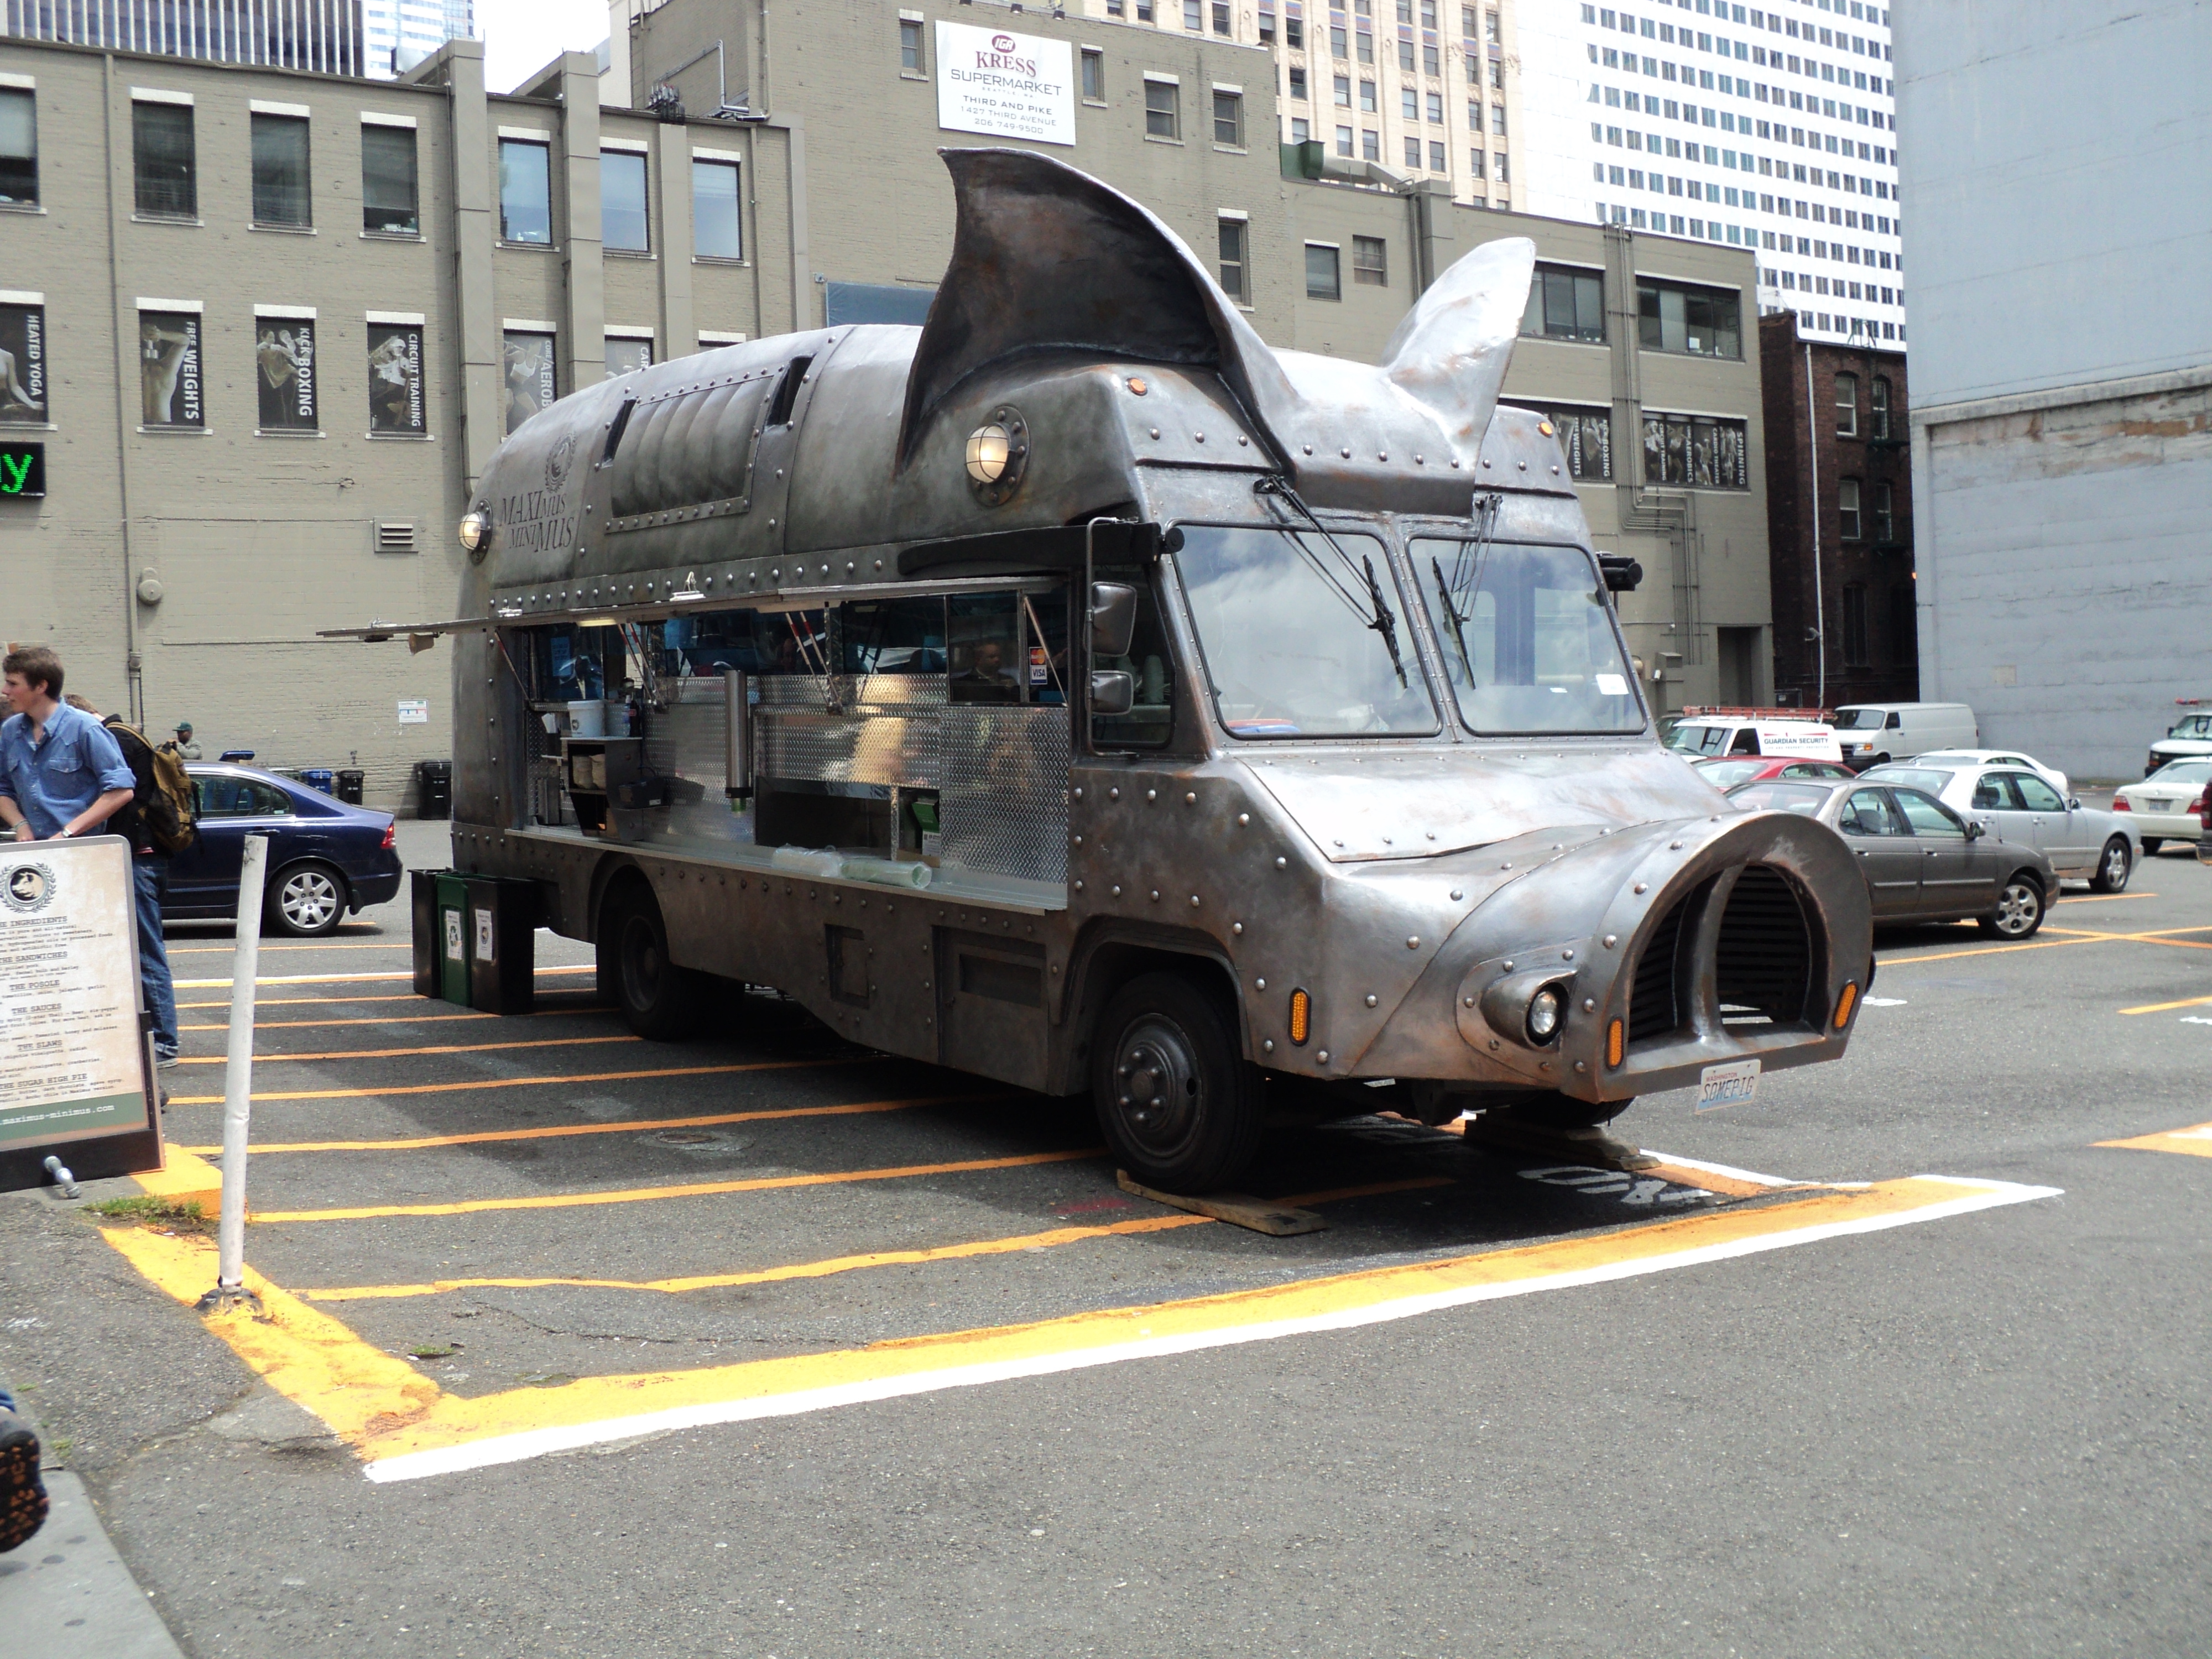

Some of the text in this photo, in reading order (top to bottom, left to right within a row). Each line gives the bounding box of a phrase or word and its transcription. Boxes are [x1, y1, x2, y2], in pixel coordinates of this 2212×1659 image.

[995, 38, 1014, 50] IGA
[976, 51, 1036, 77] KRESS
[951, 69, 1062, 96] SUPERMARKET
[963, 95, 1052, 115] THIRD AND PIKE
[961, 106, 1057, 126] 1427 THIRD AVENUE
[997, 121, 1044, 134] 749-9500
[27, 315, 43, 396] HEATED YOGA
[184, 321, 200, 419] FREE WEIGHTS
[299, 328, 312, 416] KICK BOXING
[409, 333, 421, 426] CIRCUIT TRAINING
[1737, 432, 1745, 484] SPINNING
[499, 490, 566, 526] MAXIMUS
[509, 517, 574, 552] MINIMUS
[1032, 669, 1045, 677] VISA
[11, 916, 67, 927] INGREDIENTS
[15, 951, 67, 962] SANDWICHES
[29, 980, 60, 989] POSOLE
[31, 1003, 62, 1012] SAUCES
[36, 1040, 62, 1048] SLAWS
[18, 1079, 43, 1087] SUGAR
[48, 1076, 68, 1084] HIGH
[1706, 1072, 1738, 1082] WASHINGTON
[1702, 1076, 1754, 1102] SOMEPIG
